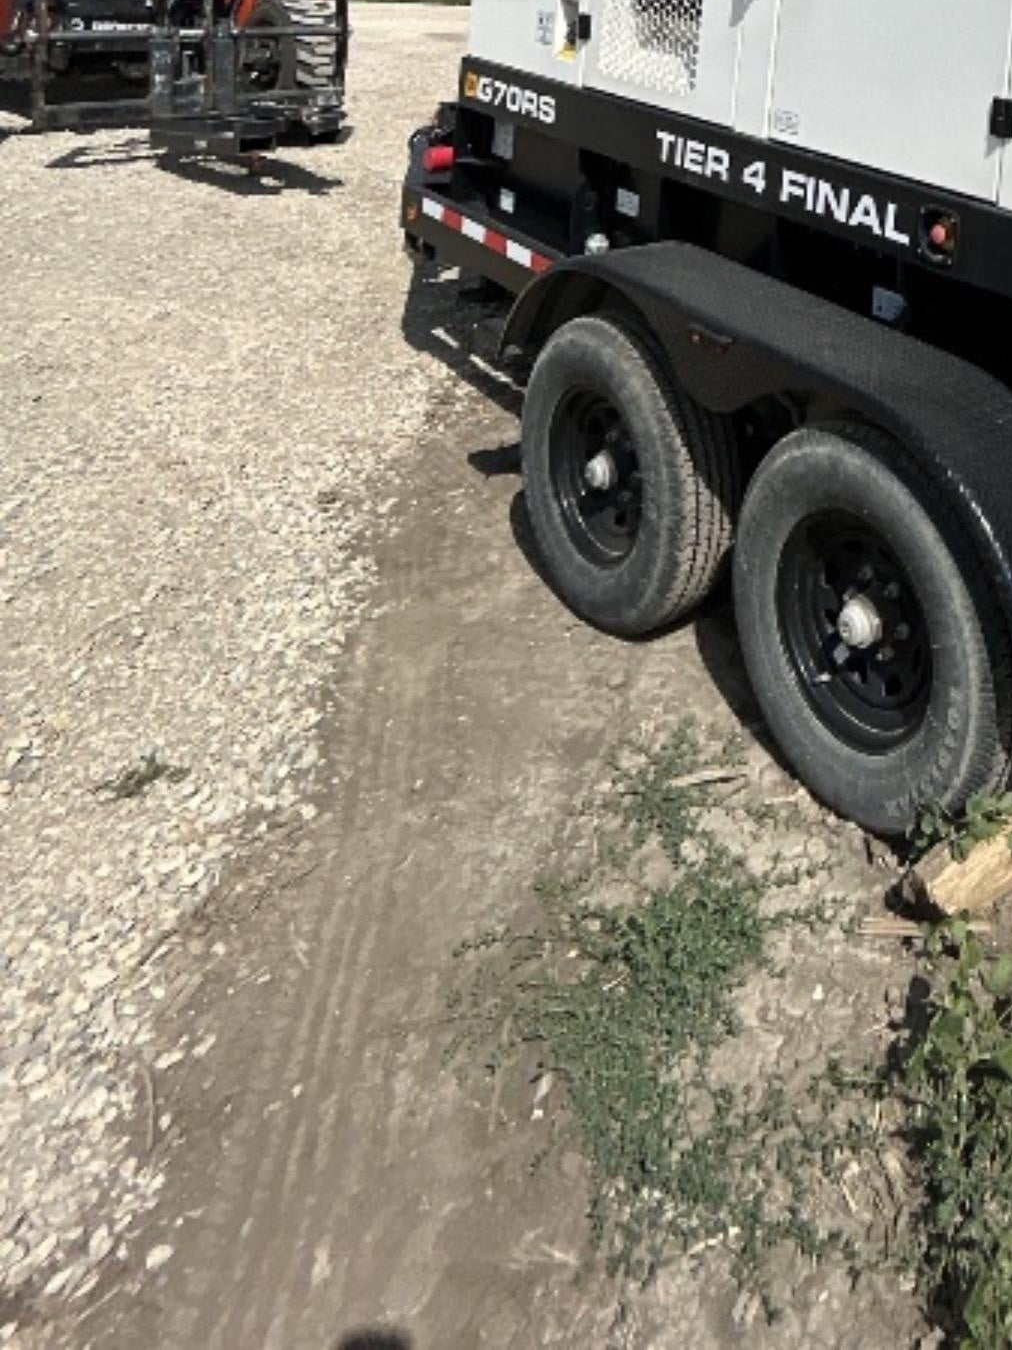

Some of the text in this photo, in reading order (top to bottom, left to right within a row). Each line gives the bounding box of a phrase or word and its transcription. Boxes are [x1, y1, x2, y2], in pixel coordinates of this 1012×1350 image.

[478, 76, 556, 124] G70RS
[655, 129, 910, 247] TIER 4 FINAL
